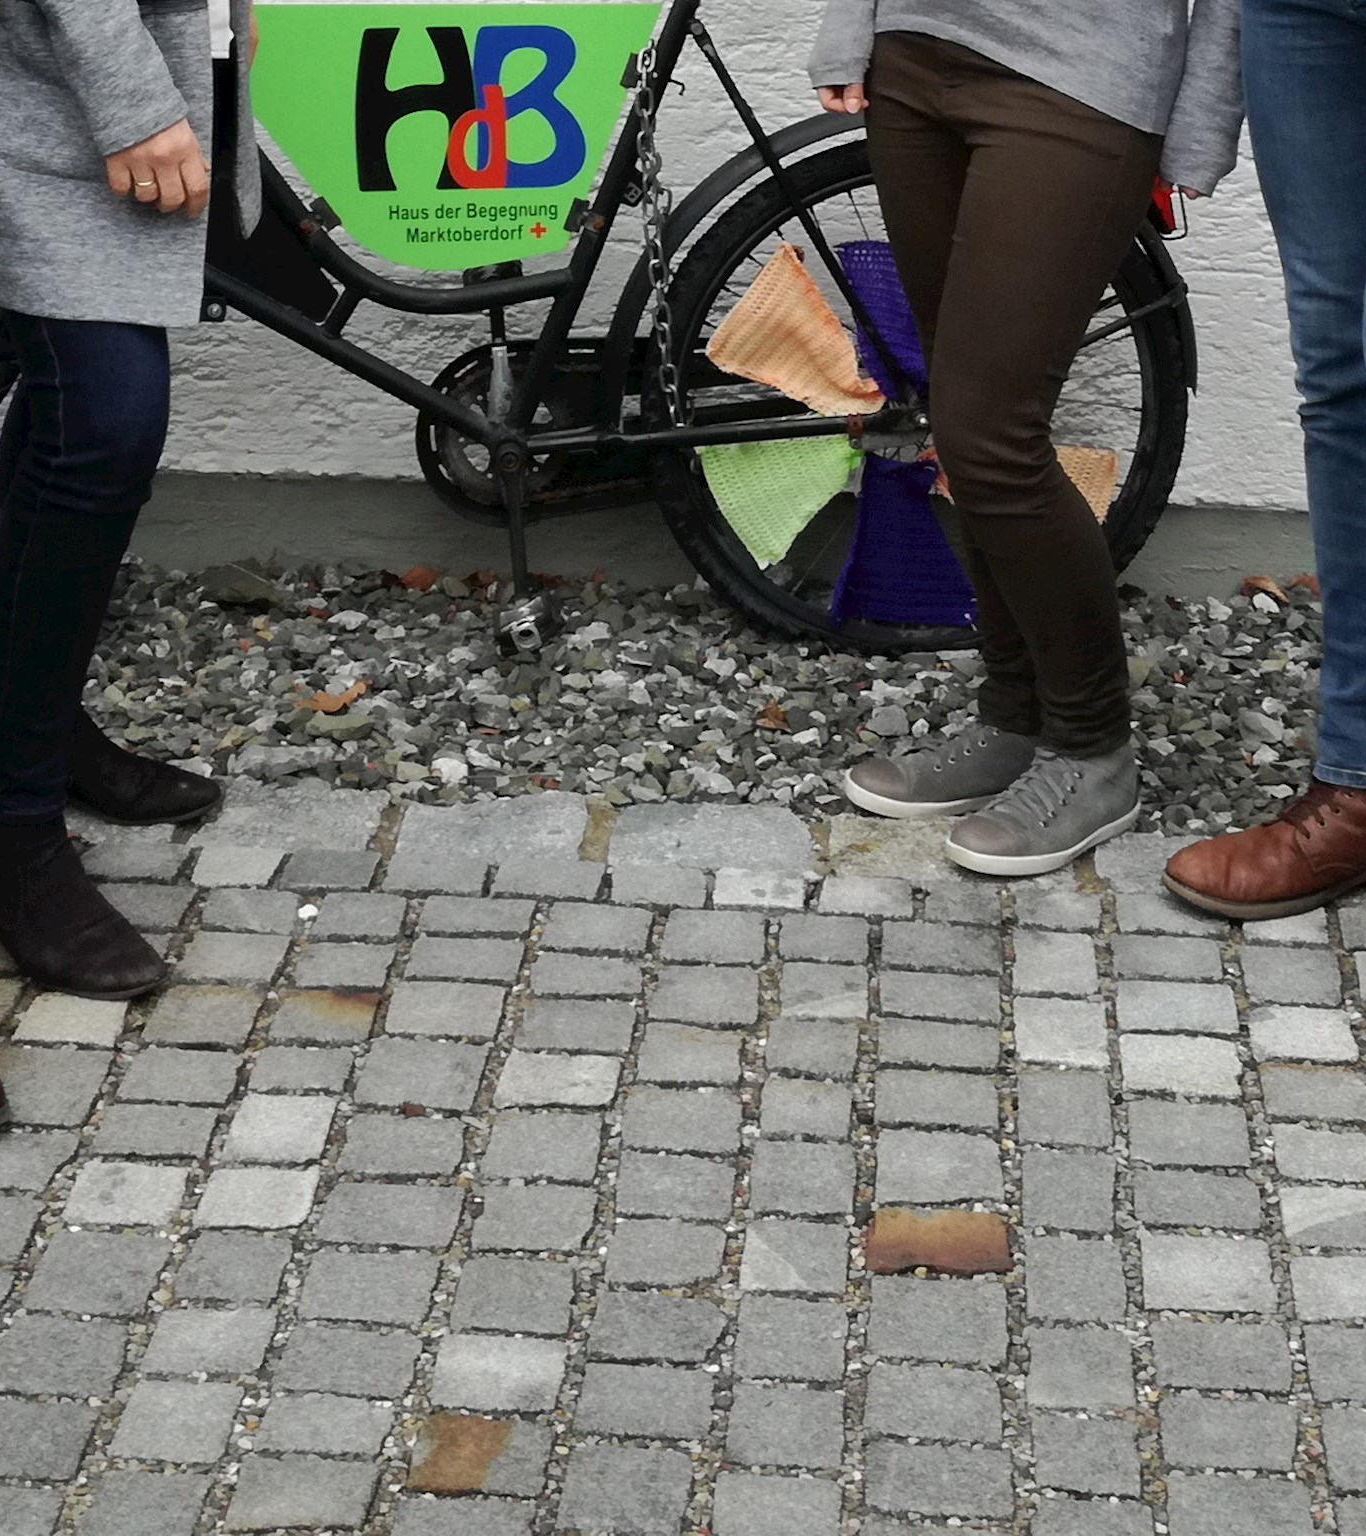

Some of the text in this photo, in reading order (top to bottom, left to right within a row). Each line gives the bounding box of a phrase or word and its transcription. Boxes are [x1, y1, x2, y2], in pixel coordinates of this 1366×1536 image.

[355, 25, 586, 191] HdB
[388, 202, 558, 221] Haus der Begegnung
[406, 224, 523, 243] Marktoberdorf
